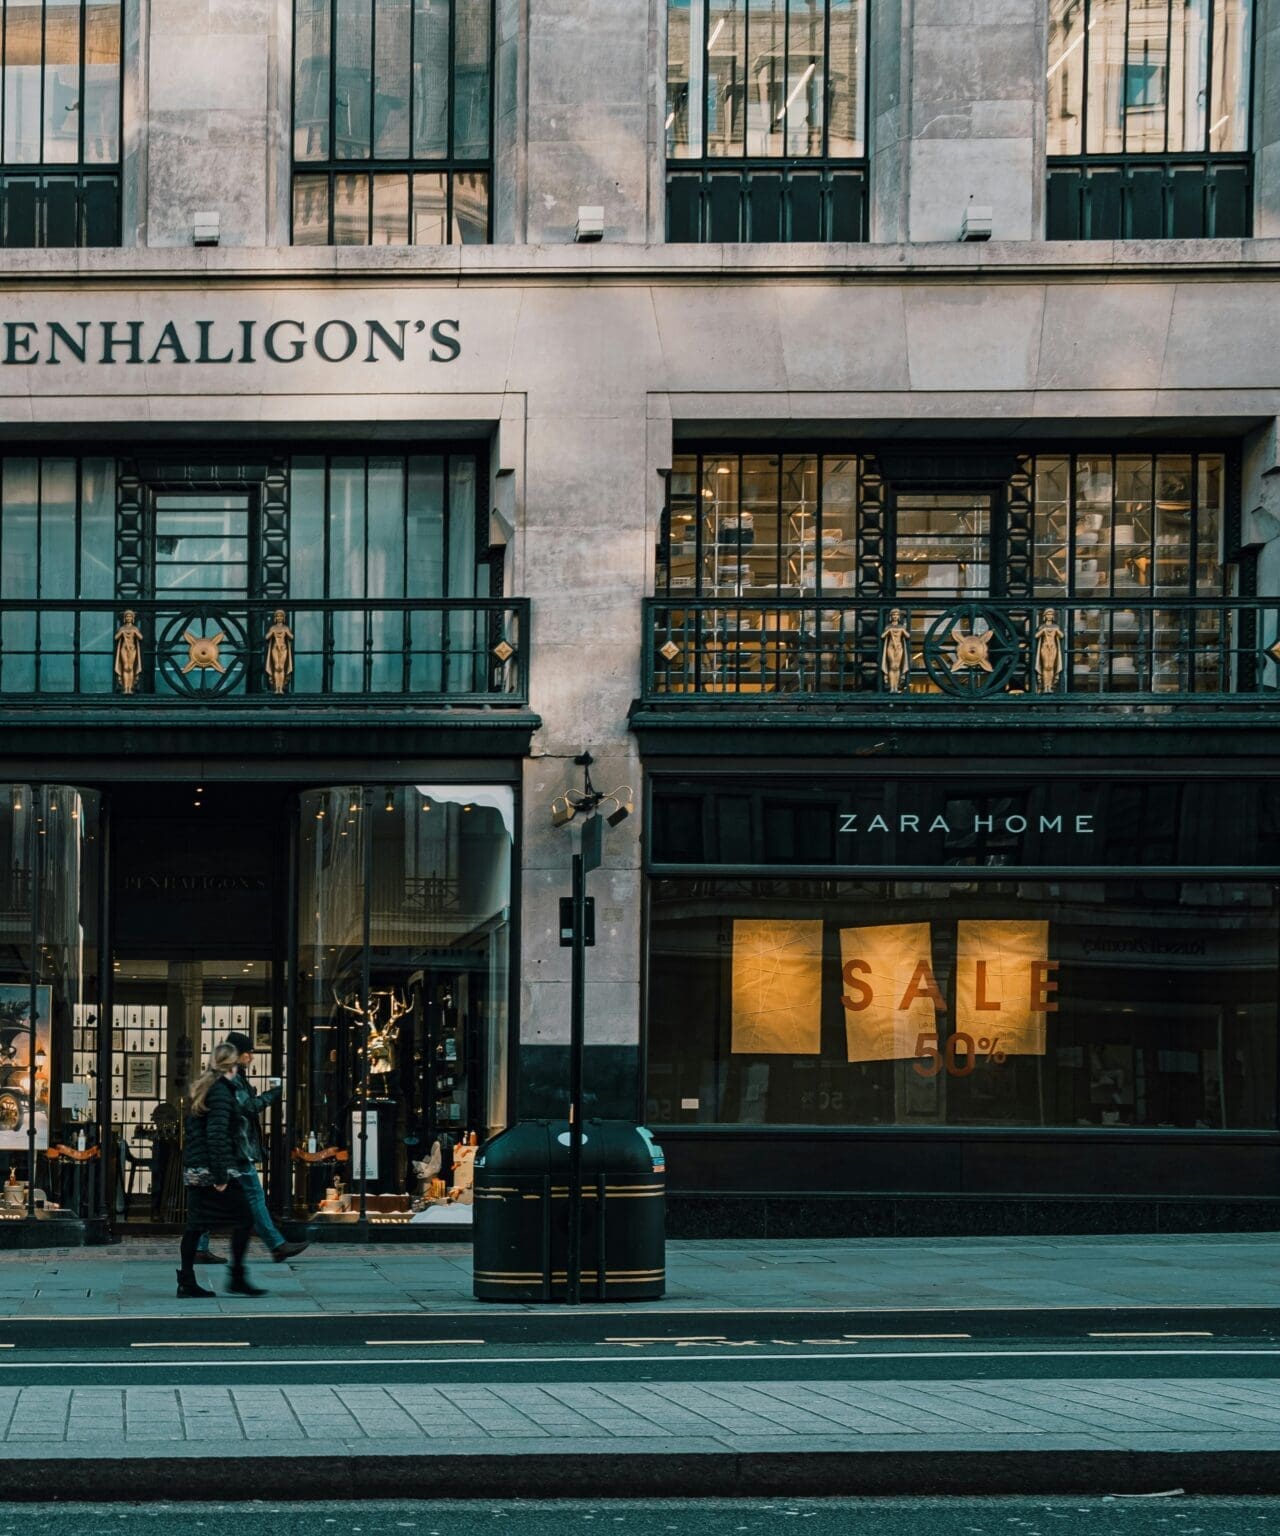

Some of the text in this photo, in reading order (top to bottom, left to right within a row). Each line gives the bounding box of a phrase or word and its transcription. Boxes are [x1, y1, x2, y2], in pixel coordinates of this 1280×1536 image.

[839, 814, 1094, 833] ZARA HOME
[841, 959, 1059, 1011] SALE
[912, 1032, 1007, 1077] 50%
